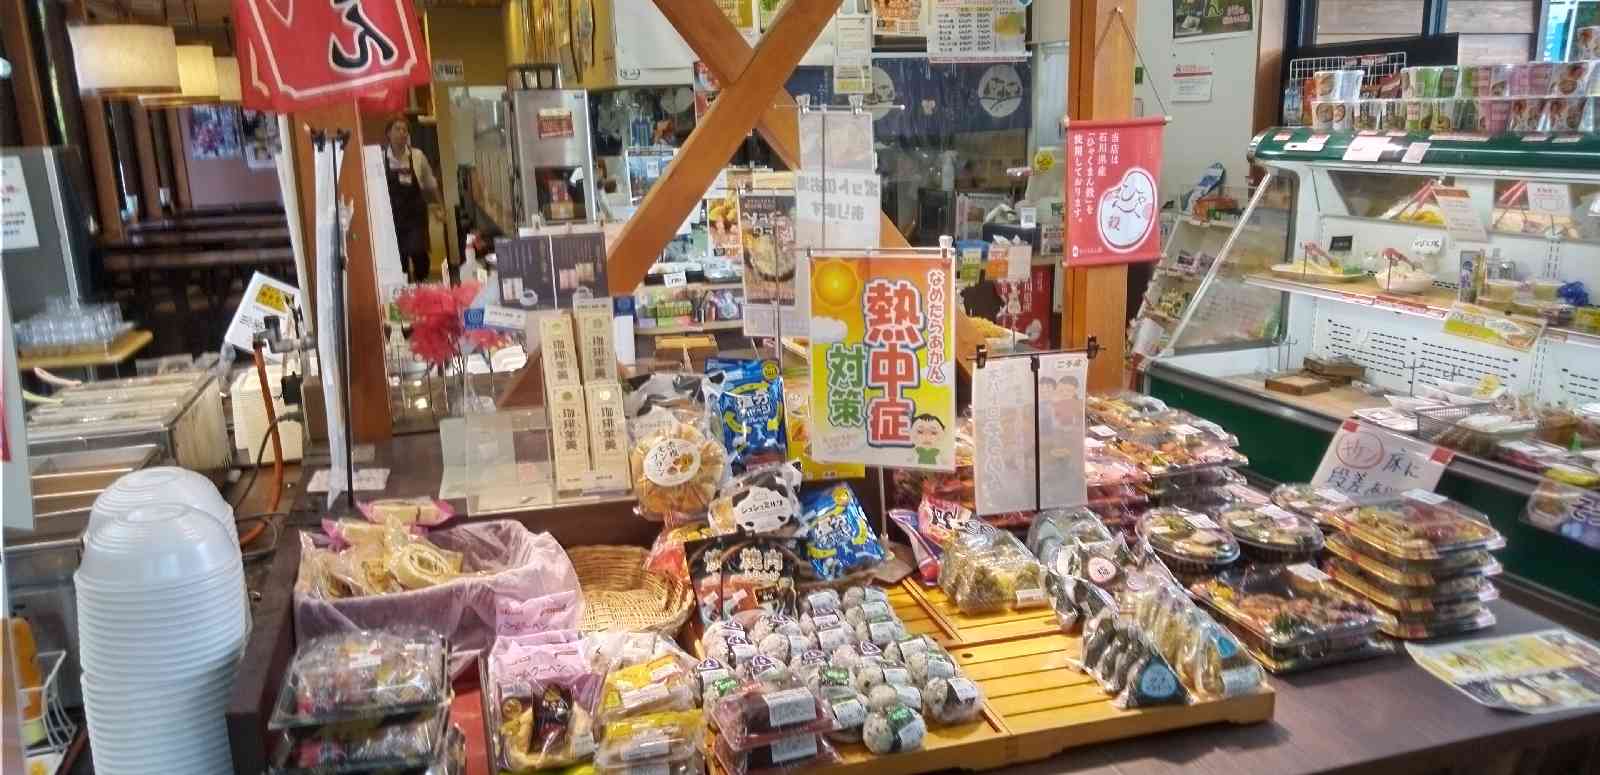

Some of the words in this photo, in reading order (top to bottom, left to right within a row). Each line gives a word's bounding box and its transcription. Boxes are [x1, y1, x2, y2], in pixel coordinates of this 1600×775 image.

[1072, 132, 1084, 223] 使用しております。
[1097, 131, 1108, 177] 石川県産
[1110, 132, 1120, 165] 当店は
[865, 280, 925, 447] 熱中症
[927, 270, 946, 385] なめたらあかん
[827, 343, 866, 427] 対策
